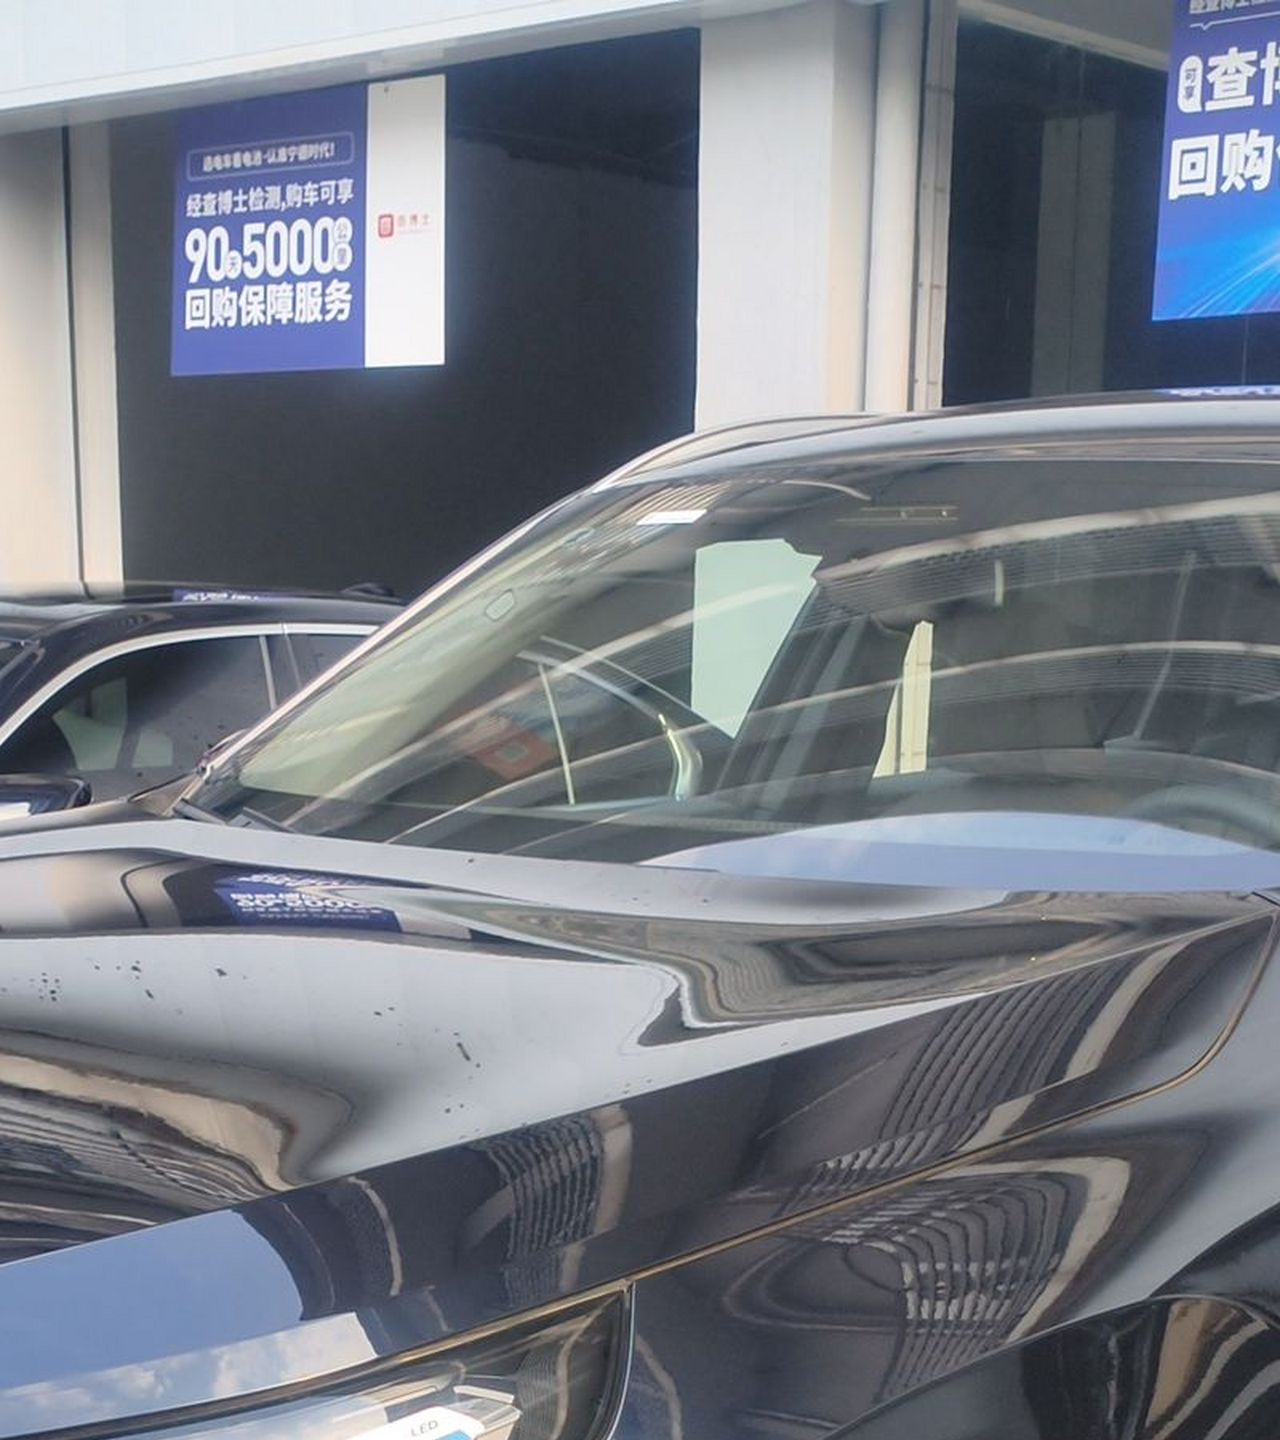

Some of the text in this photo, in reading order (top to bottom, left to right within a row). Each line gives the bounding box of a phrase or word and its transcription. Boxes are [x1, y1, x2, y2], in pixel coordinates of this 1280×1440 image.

[185, 279, 352, 330] 回购保障服务
[411, 1419, 438, 1437] LED
